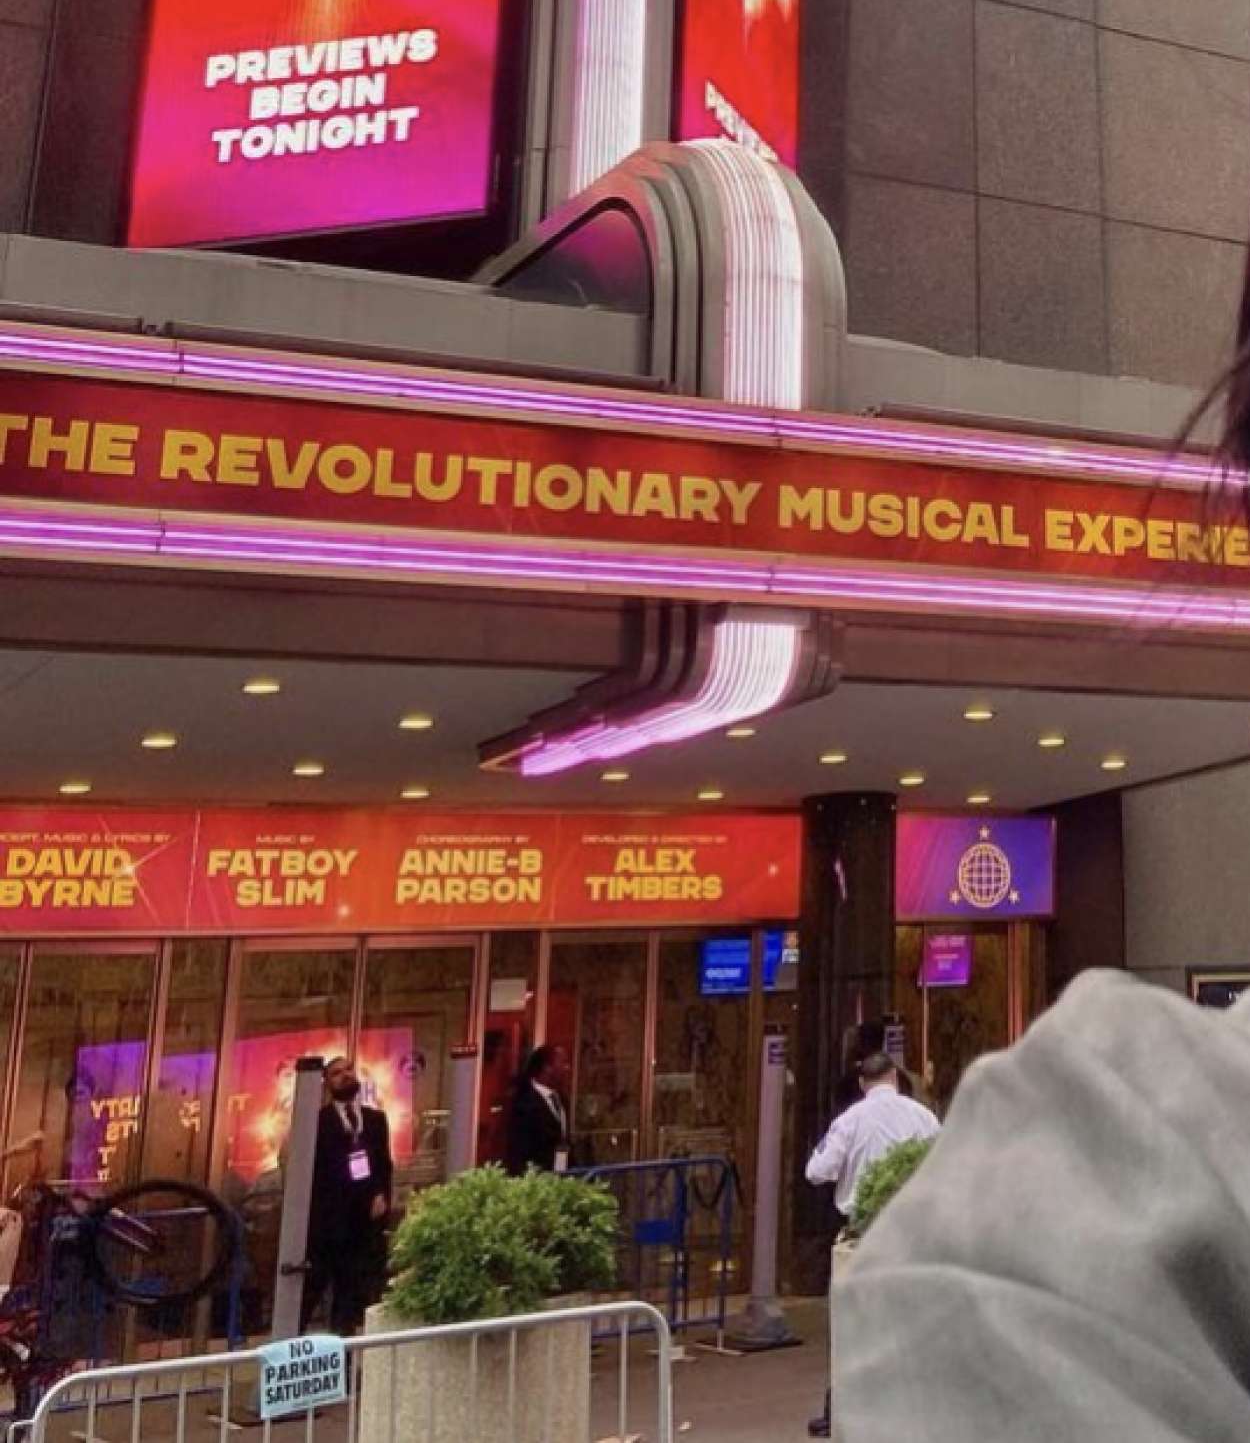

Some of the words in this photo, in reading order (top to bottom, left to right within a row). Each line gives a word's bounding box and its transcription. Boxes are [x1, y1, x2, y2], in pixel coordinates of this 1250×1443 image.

[205, 29, 438, 88] PREVIEWS
[250, 72, 387, 120] BEGIN
[211, 106, 419, 163] TONIGHT
[160, 429, 762, 524] REVOLUTIONARY
[778, 486, 1029, 547] MUSICAL
[6, 848, 136, 876] DAVID
[207, 849, 358, 876] FATBOY
[399, 848, 543, 874] ANNIE-B
[614, 848, 697, 873] ALEX
[0, 878, 136, 906] BYRNE
[236, 878, 325, 906] SLIM
[395, 876, 541, 904] PARSON
[585, 876, 723, 901] TIMBERS
[289, 1340, 314, 1360] NO
[264, 1352, 341, 1385] PARKING
[265, 1373, 341, 1406] SATURDAY
